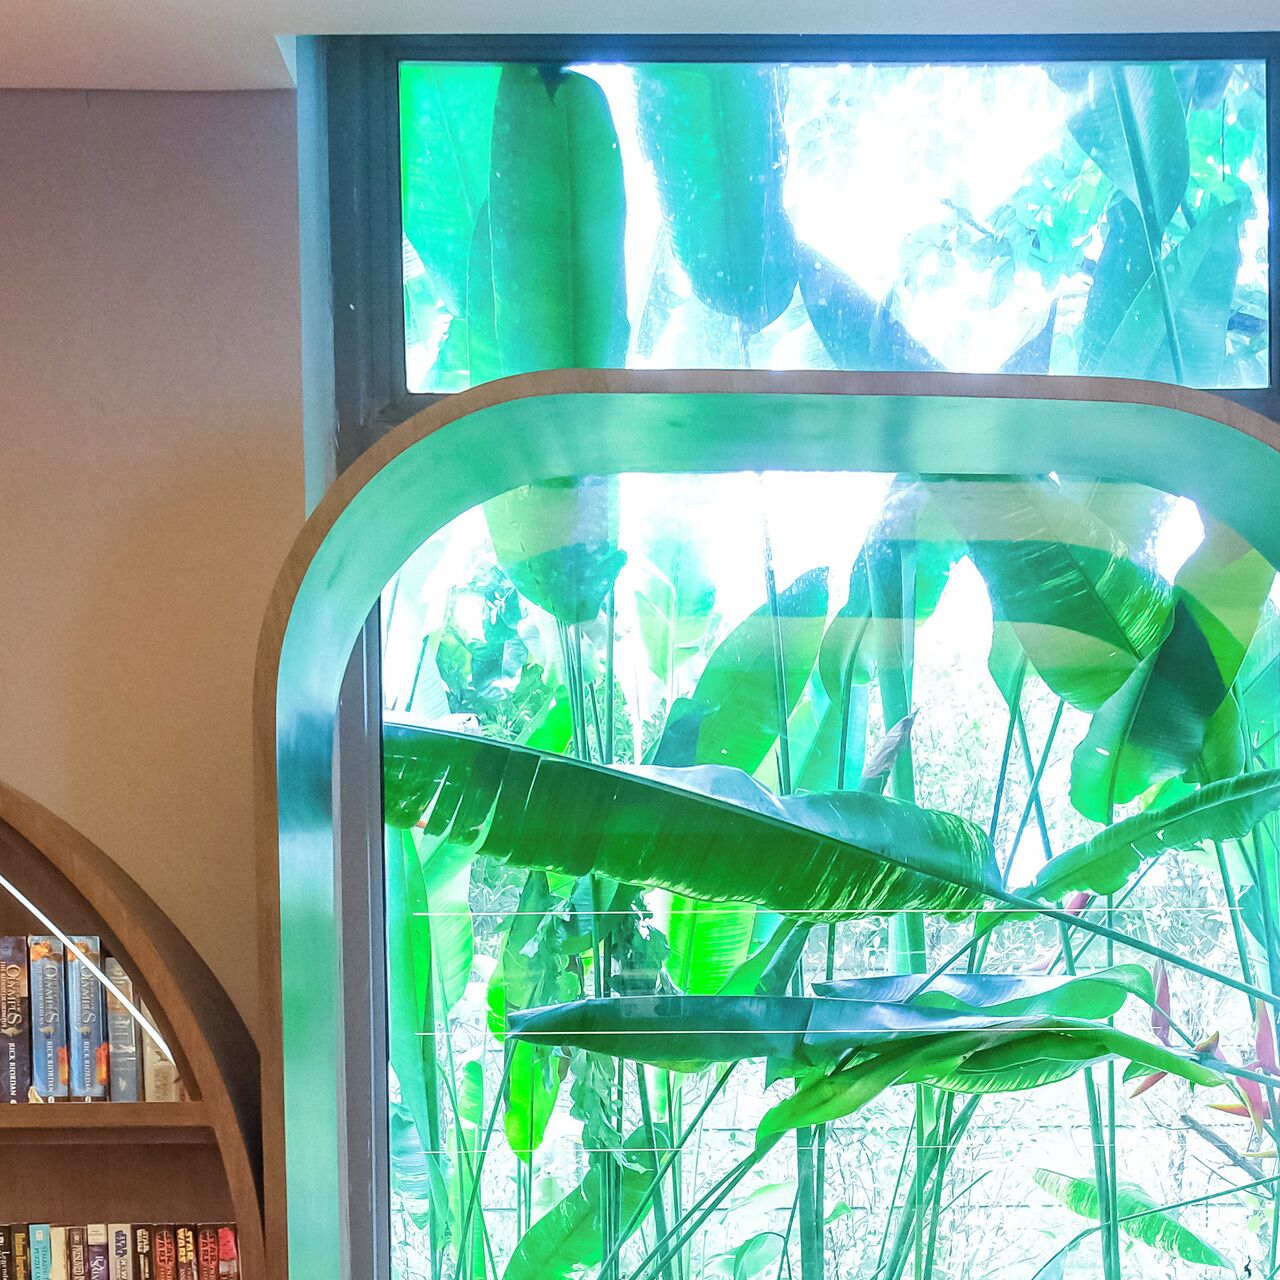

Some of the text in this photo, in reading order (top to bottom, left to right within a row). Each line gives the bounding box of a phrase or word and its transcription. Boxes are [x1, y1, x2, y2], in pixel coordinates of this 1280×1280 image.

[7, 964, 22, 1024] OLYMPUS
[43, 964, 59, 1024] OLYMPUS
[80, 963, 96, 1023] OLYMPUS
[9, 1062, 17, 1096] RIORDAN
[73, 1245, 84, 1275] PRESUMED
[158, 1232, 166, 1266] WARS
[177, 1228, 186, 1263] WARS
[201, 1230, 209, 1264] WARS
[209, 1235, 217, 1263] STAR
